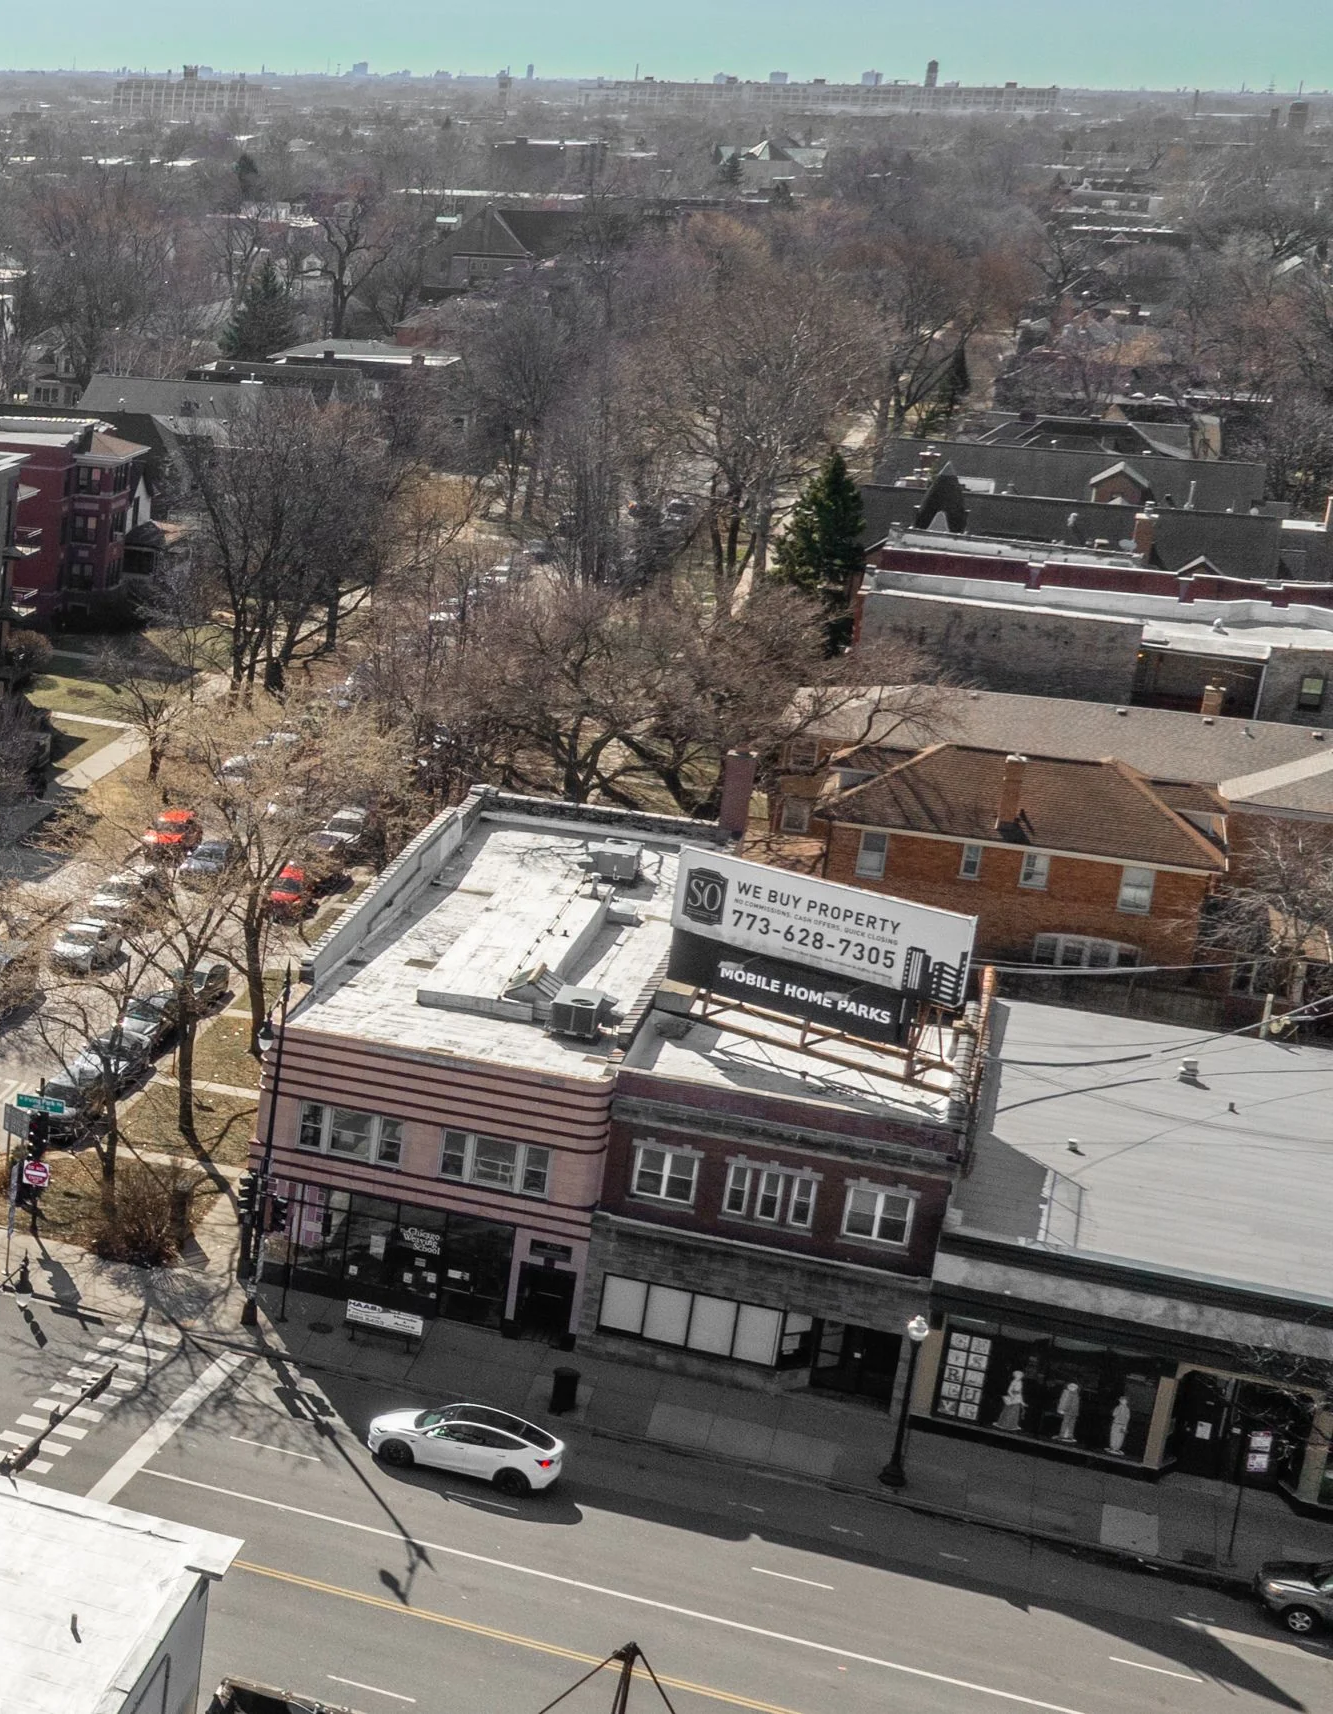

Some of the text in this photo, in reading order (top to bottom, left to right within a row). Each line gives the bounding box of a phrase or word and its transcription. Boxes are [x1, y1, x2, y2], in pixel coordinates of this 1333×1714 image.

[686, 878, 722, 911] SO
[737, 880, 901, 935] WE BUY PROPERTY
[732, 908, 896, 969] 773-628-7305
[793, 913, 812, 925] CASH
[844, 926, 867, 939] QUICK
[867, 932, 899, 947] CLOSING
[719, 966, 892, 1025] MOBILE HOME PARKS
[413, 1242, 441, 1256] School
